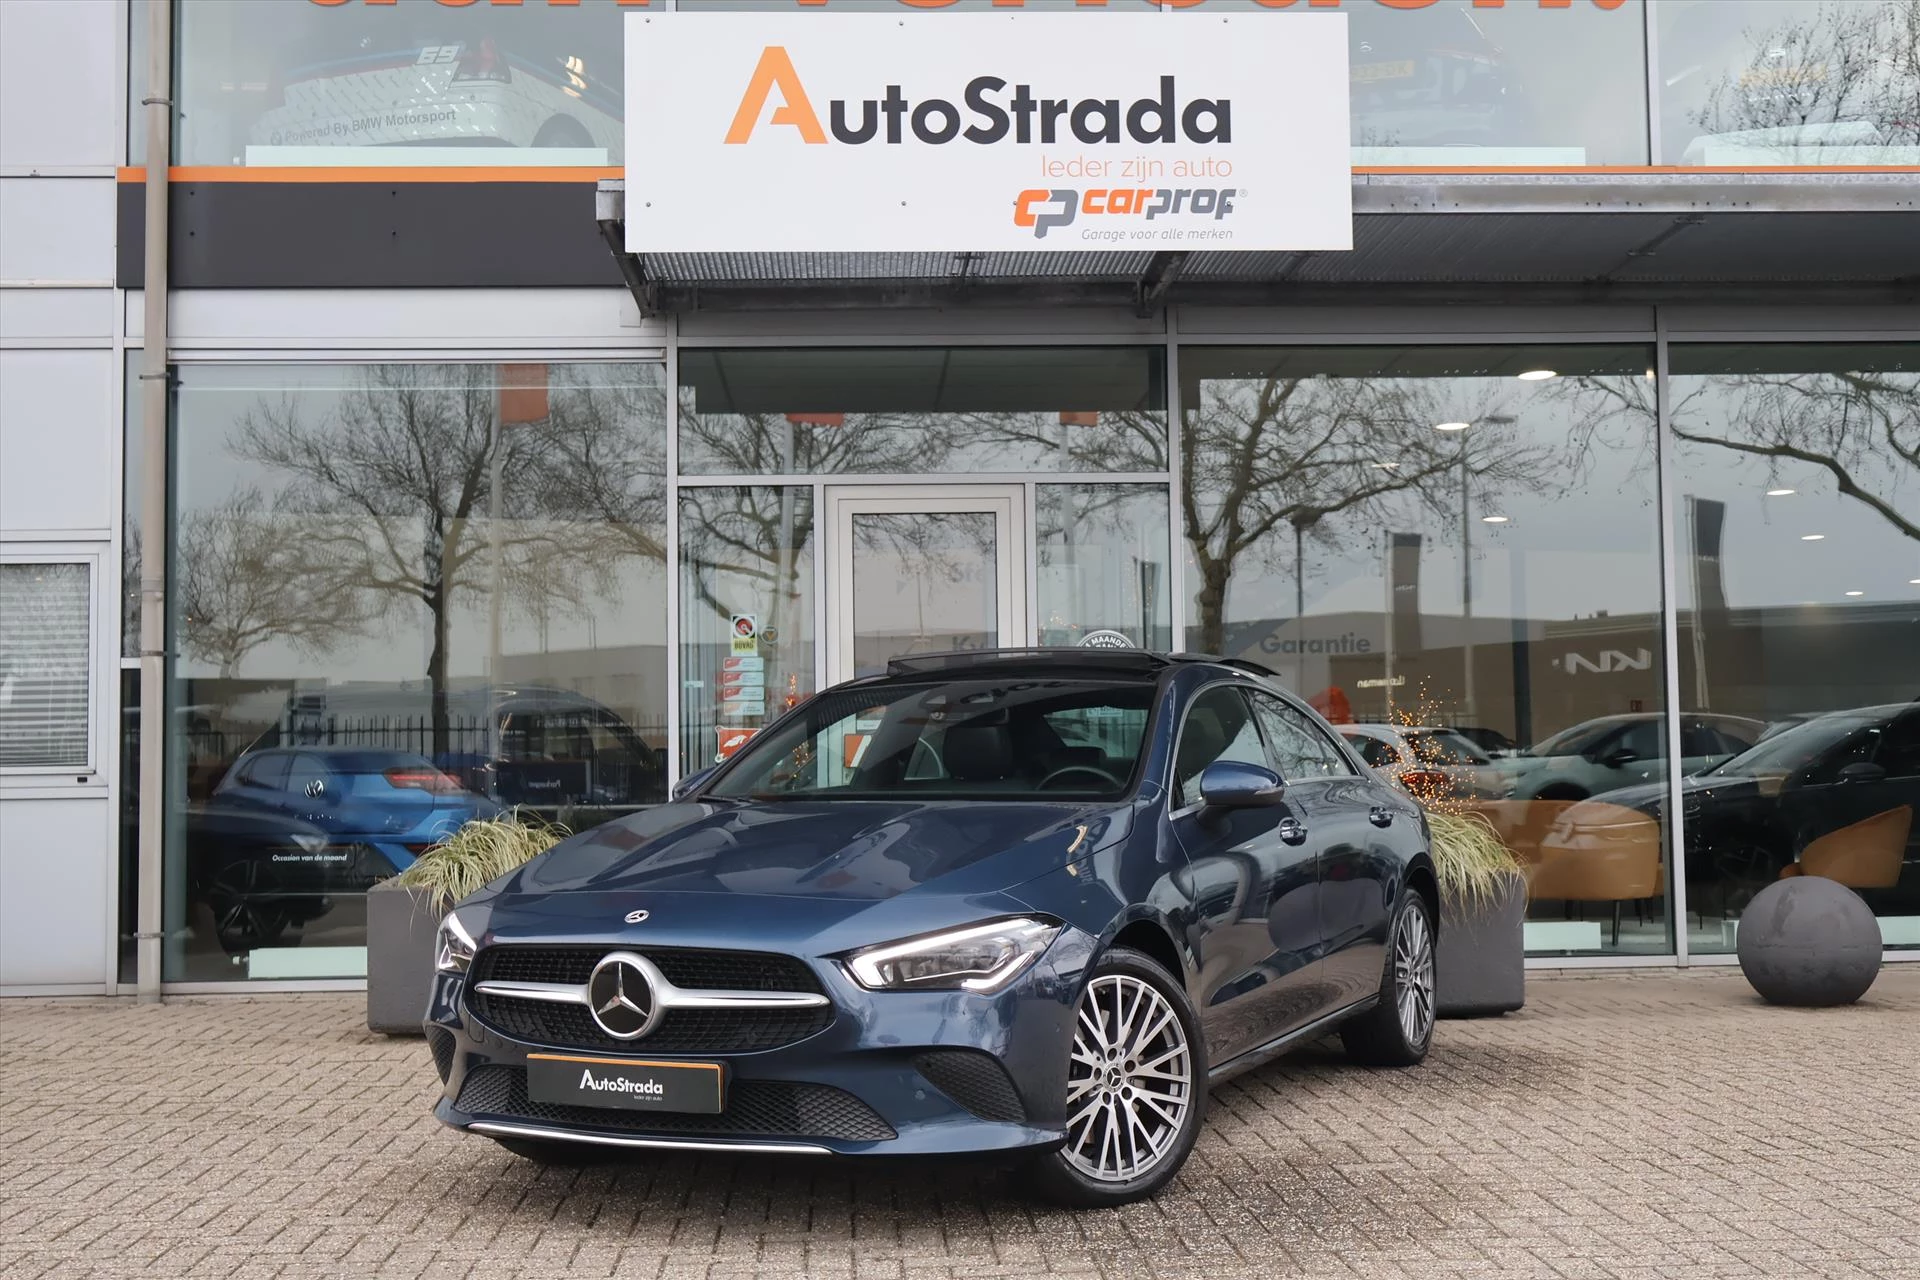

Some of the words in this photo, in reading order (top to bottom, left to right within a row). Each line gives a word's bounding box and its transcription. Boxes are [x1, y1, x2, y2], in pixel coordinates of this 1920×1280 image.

[417, 45, 460, 65] 69
[723, 46, 1232, 145] AutoStrada
[285, 125, 330, 142] Powered
[334, 121, 349, 137] By
[352, 116, 383, 132] BMW
[386, 110, 457, 127] Motorsport
[1041, 155, 1113, 178] Ieder
[1120, 156, 1164, 183] zijn
[1172, 156, 1233, 178] auto
[1081, 228, 1127, 243] Garage
[1130, 230, 1159, 241] voor
[1161, 228, 1184, 240] alle
[1187, 228, 1233, 240] merken
[1260, 632, 1371, 654] Garantie
[272, 854, 300, 862] Occasion
[314, 854, 323, 862] de
[323, 853, 348, 862] maand
[579, 1069, 663, 1095] AutoStrada
